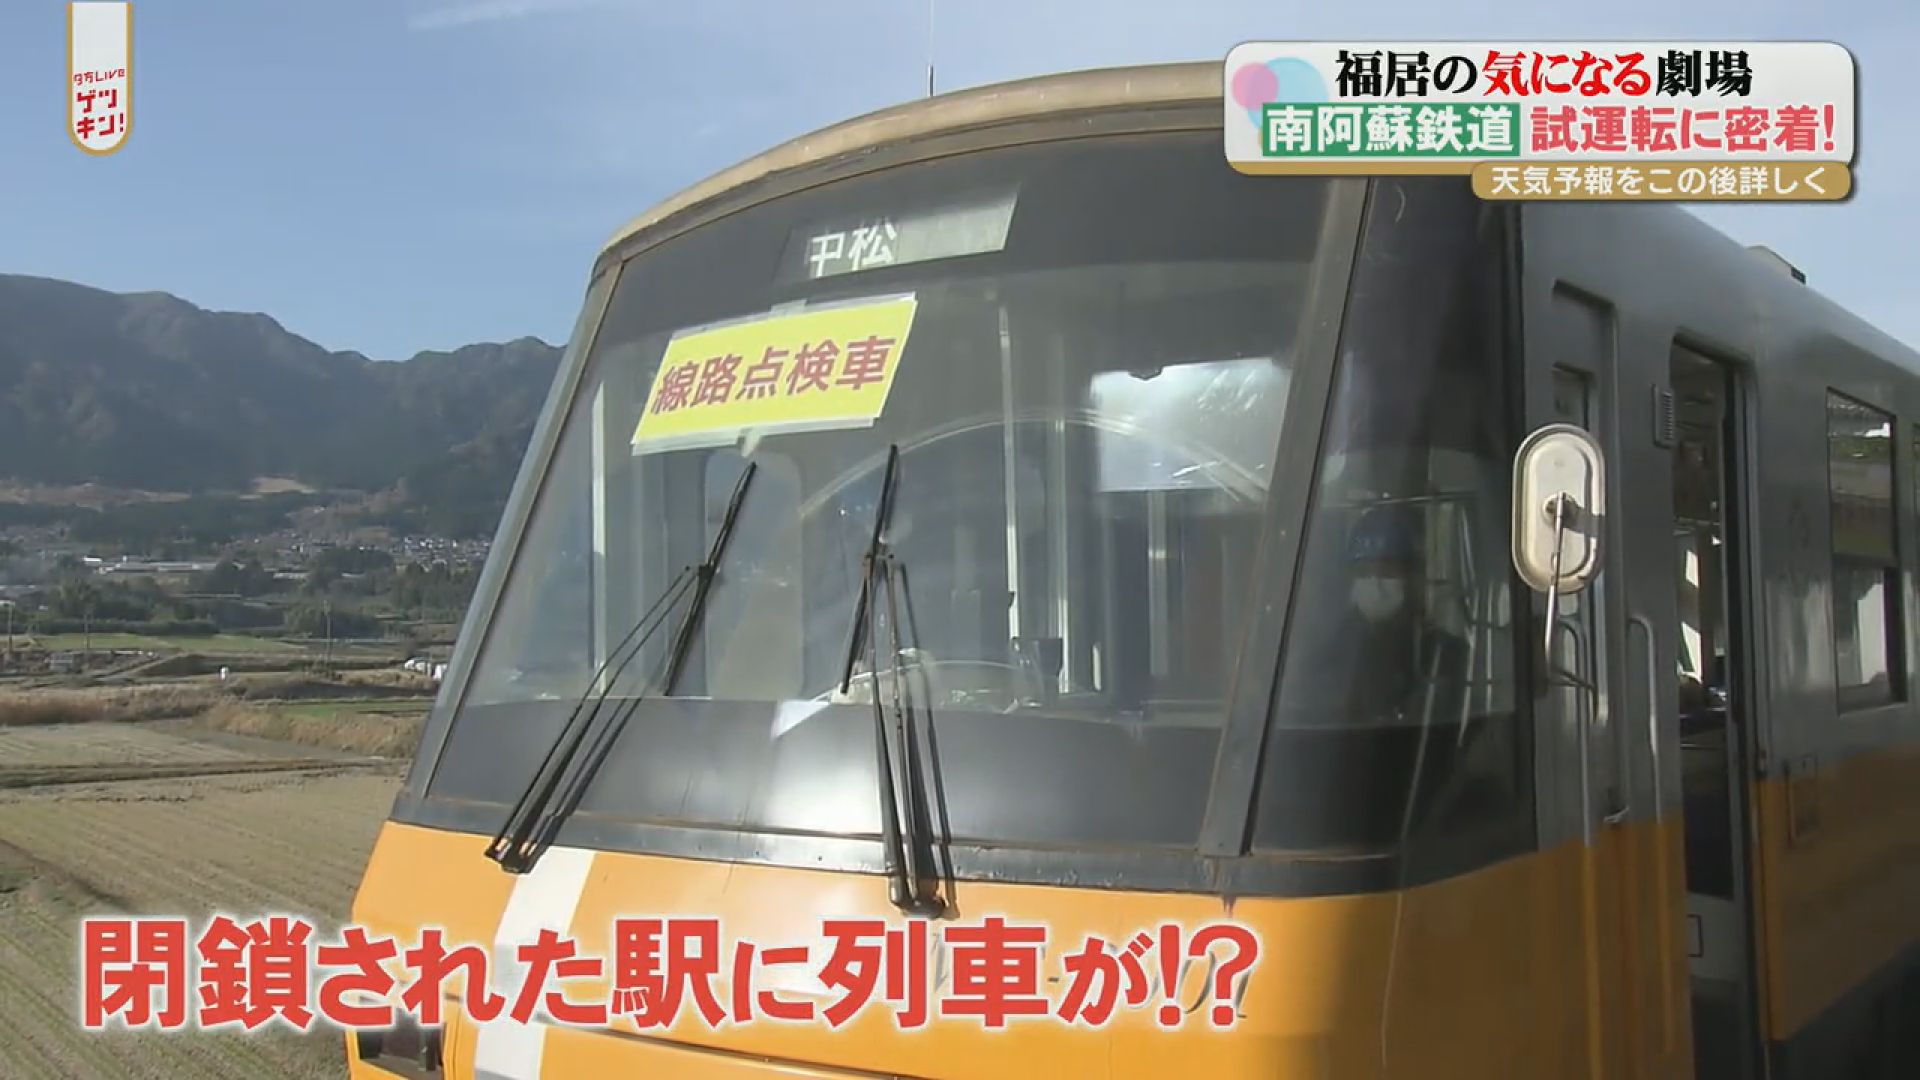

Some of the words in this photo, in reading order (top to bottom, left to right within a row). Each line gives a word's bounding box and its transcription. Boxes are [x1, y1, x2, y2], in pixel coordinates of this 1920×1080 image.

[651, 336, 895, 414] 線路点検車
